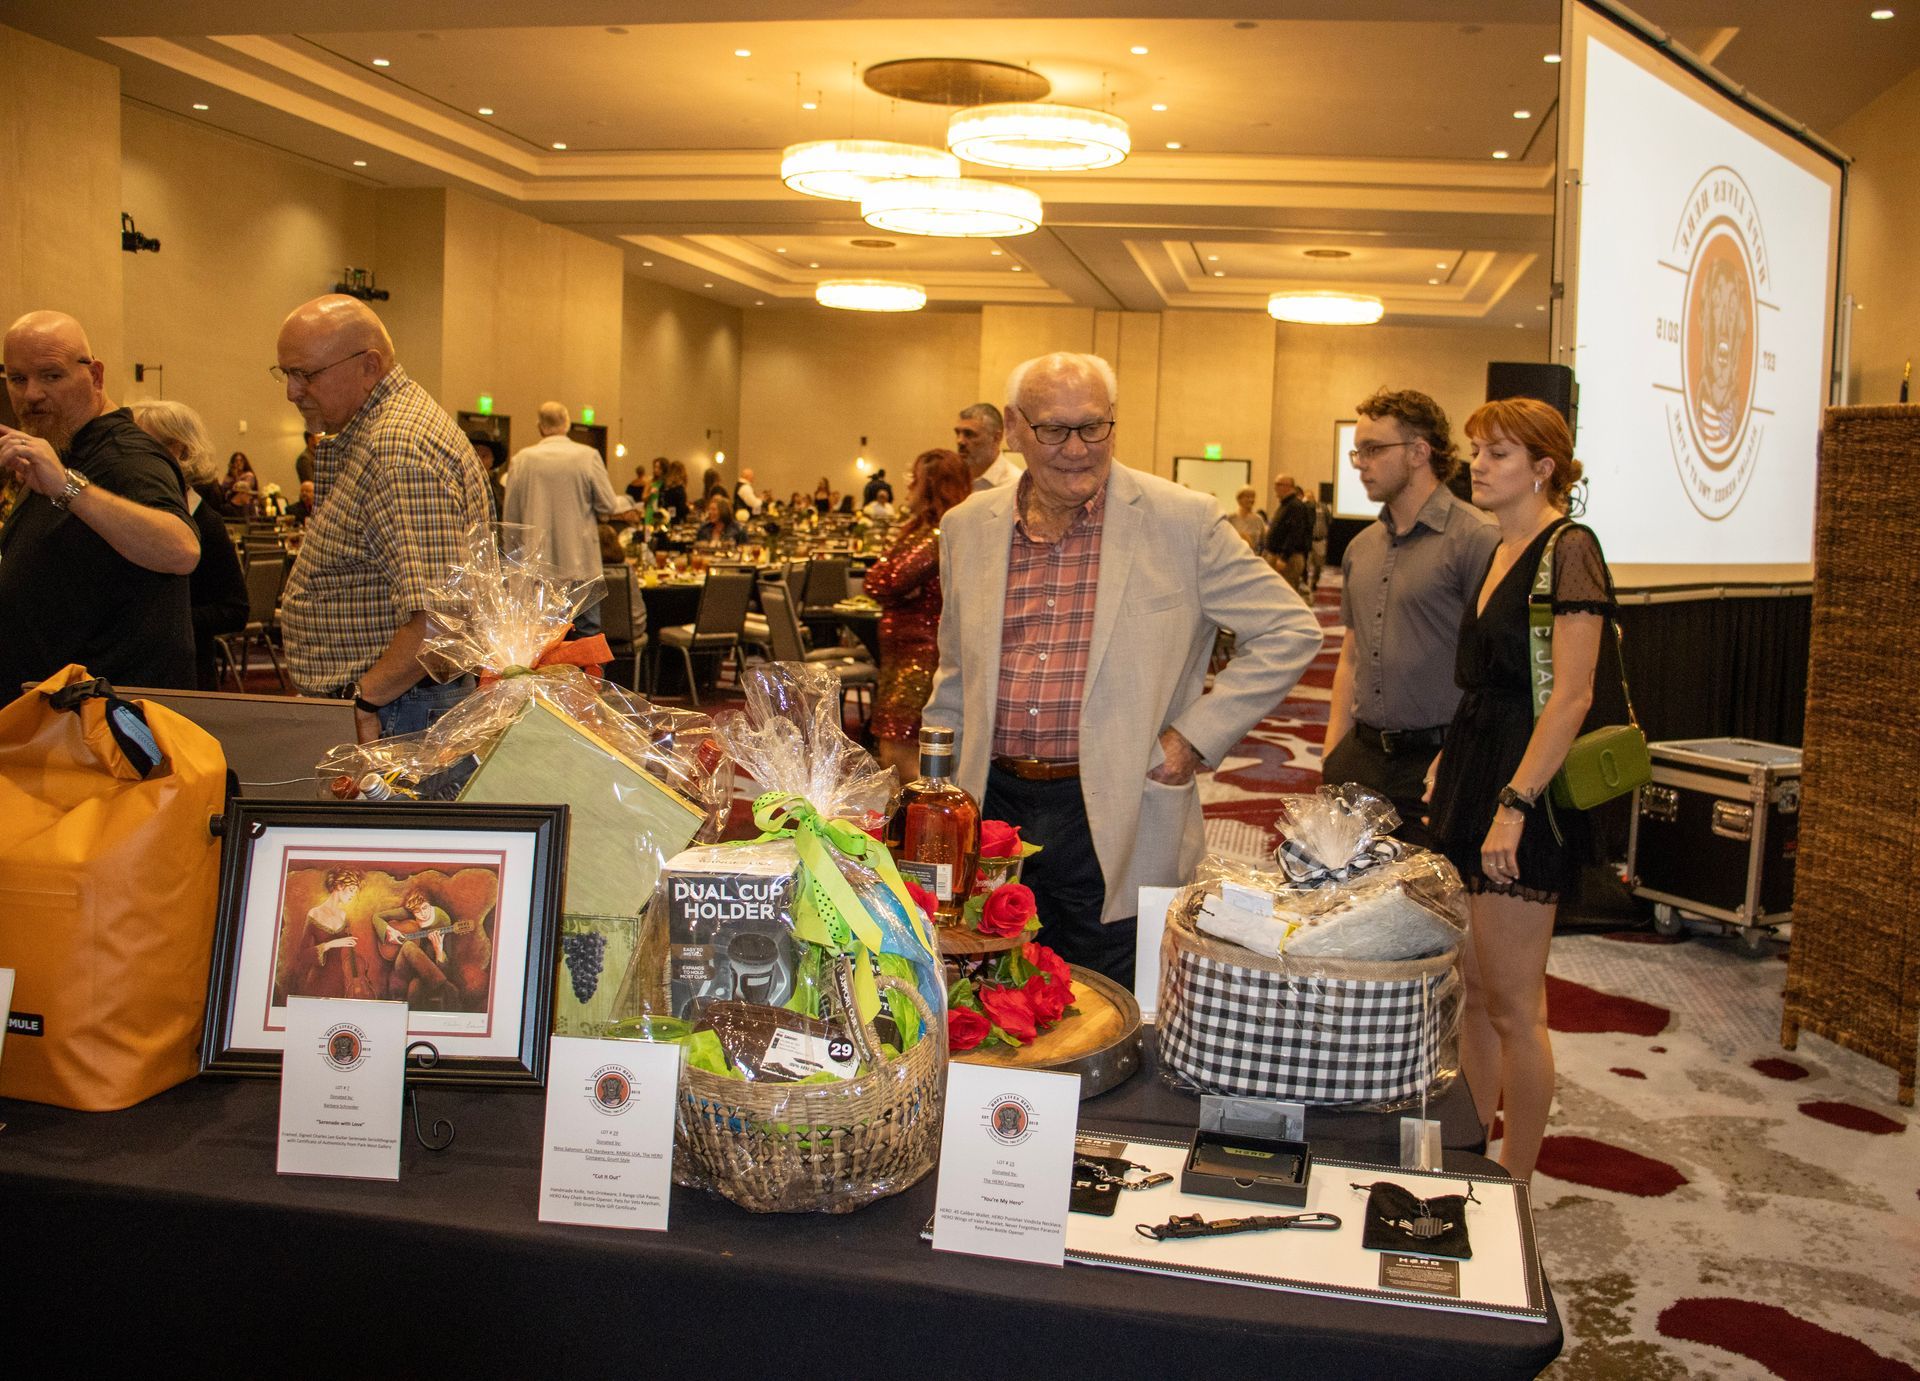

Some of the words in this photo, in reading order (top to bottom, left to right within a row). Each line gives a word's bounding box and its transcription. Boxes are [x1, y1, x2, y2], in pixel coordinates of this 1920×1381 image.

[252, 822, 261, 833] 7
[675, 883, 734, 901] DUAL
[739, 884, 783, 900] CUP
[685, 903, 774, 919] HOLDER
[839, 974, 851, 1008] SUPPORT
[7, 1018, 38, 1031] MULE
[830, 1044, 852, 1056] 29
